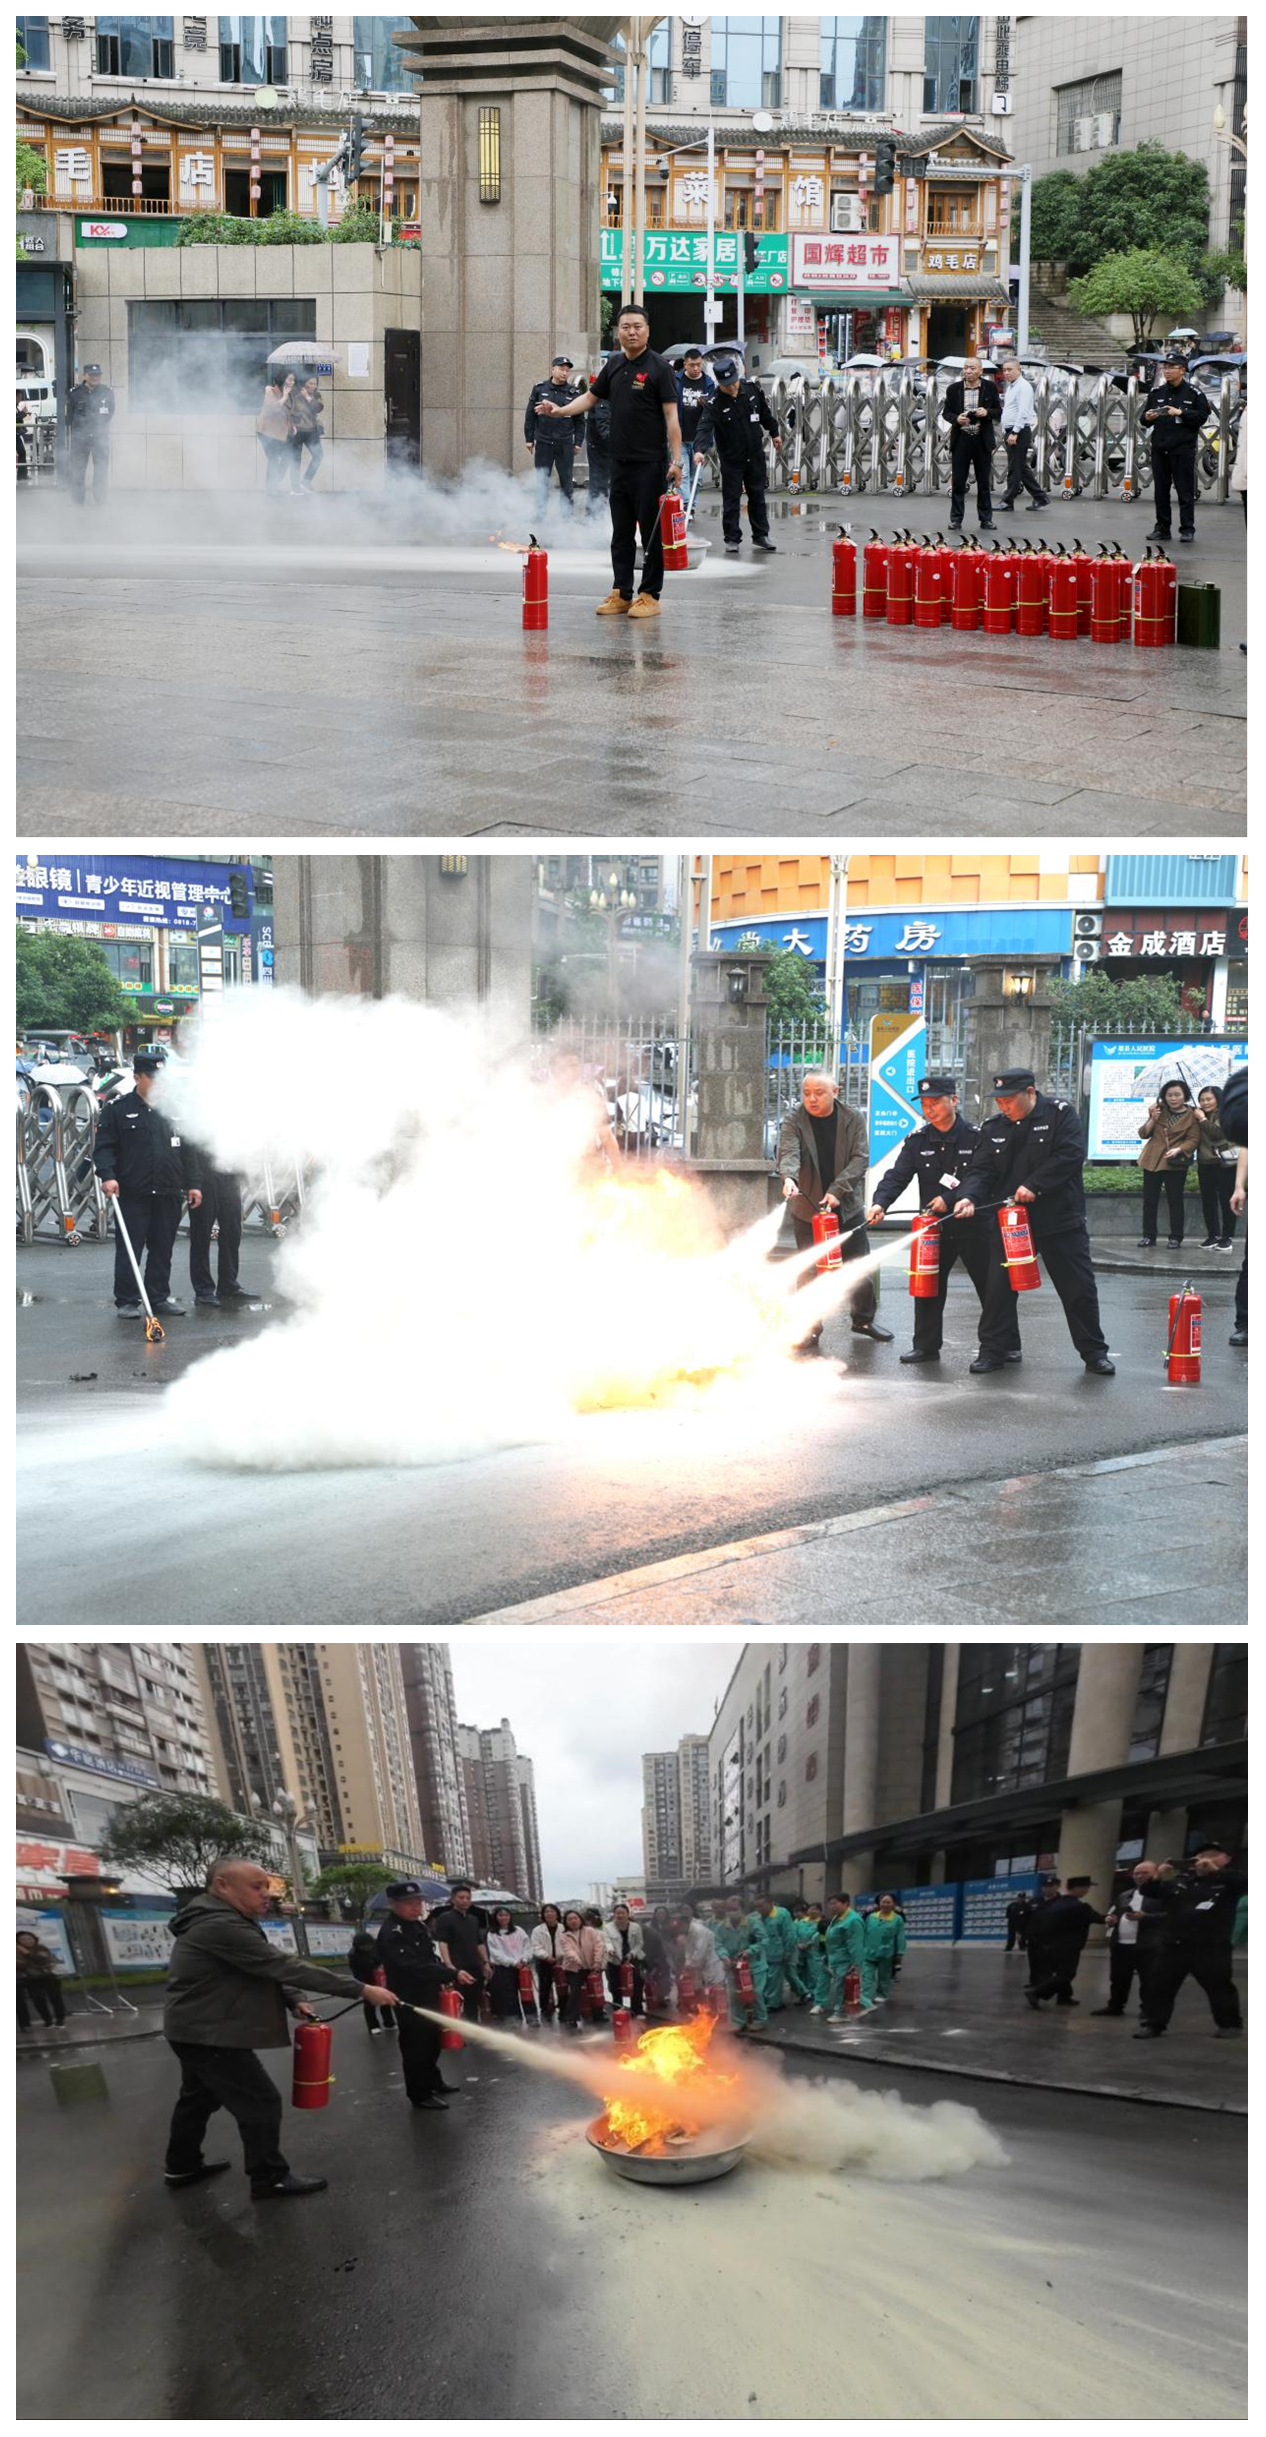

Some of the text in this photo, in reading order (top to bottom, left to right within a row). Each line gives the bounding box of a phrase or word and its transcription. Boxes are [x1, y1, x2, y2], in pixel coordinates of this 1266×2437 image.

[682, 31, 702, 79] 停车
[804, 243, 889, 267] 国辉超市
[928, 253, 977, 270] 鸡毛店
[85, 874, 232, 905] 青少年近视管理中心
[1108, 931, 1226, 957] 金成酒店
